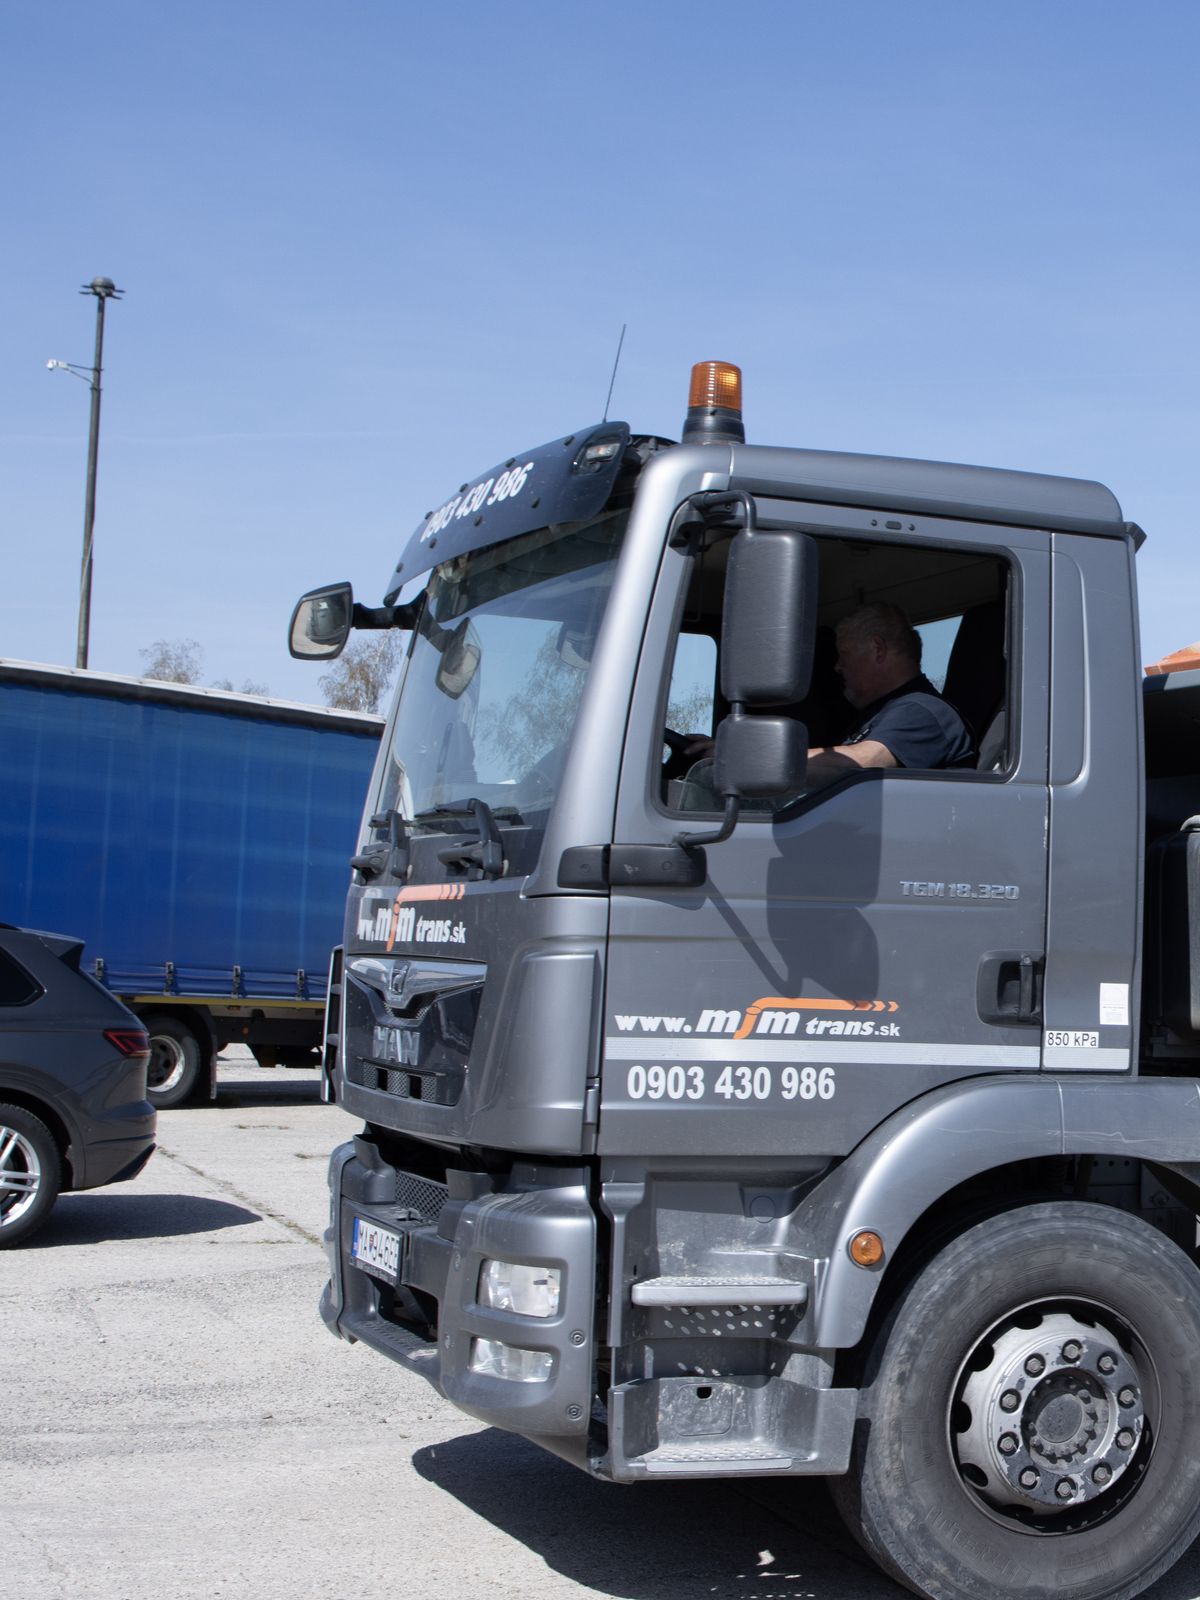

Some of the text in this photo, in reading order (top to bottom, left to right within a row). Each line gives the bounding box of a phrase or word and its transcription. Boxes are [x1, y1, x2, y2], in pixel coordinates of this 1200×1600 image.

[486, 462, 535, 506] 986
[900, 881, 1020, 900] TGM 18.320
[416, 915, 466, 943] trans.sk
[805, 1017, 901, 1038] trans.sk
[1047, 1032, 1098, 1048] 850 kPa
[373, 1025, 421, 1066] MAN
[627, 1065, 836, 1101] 0903 430 986
